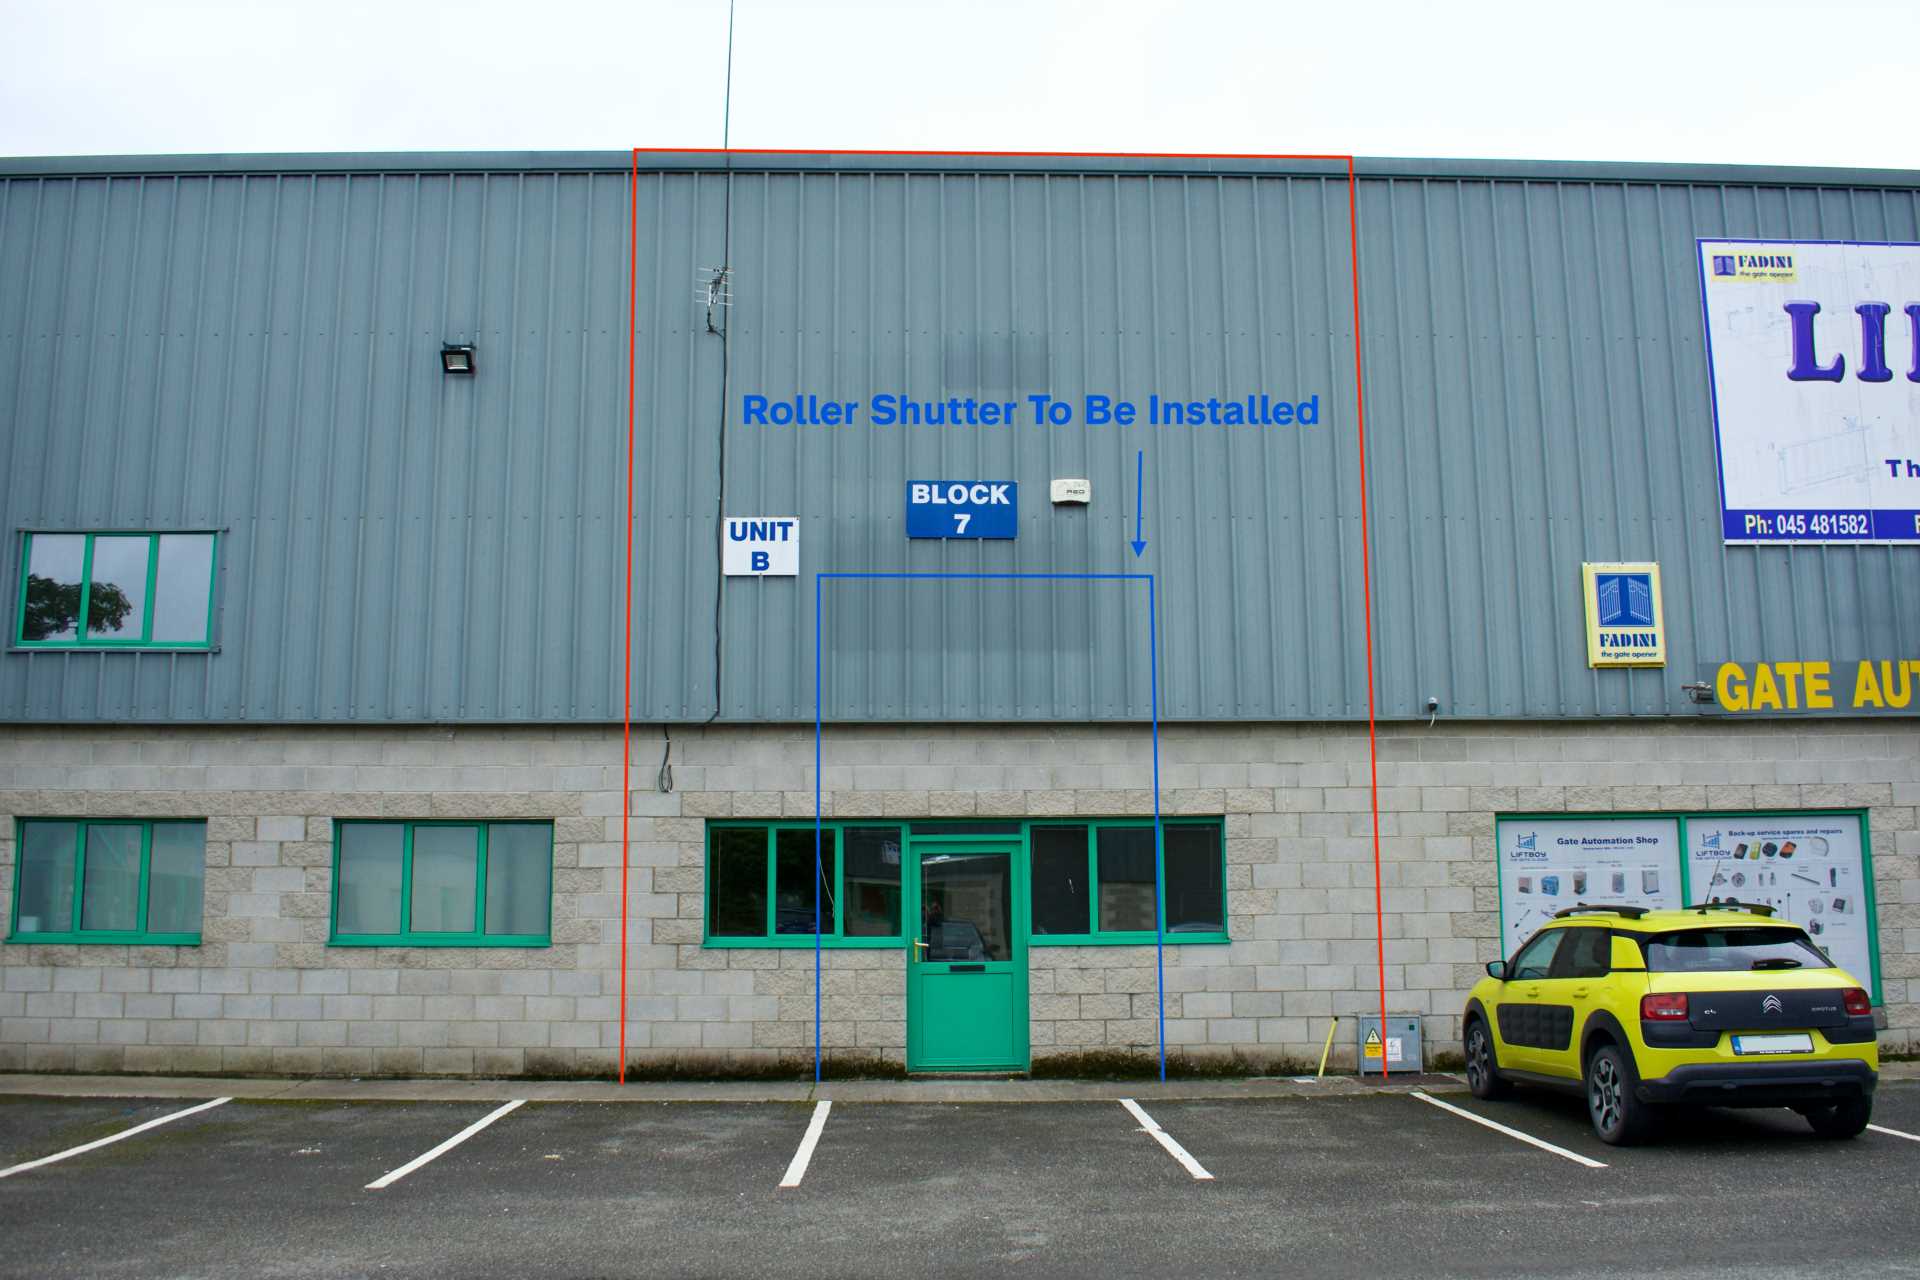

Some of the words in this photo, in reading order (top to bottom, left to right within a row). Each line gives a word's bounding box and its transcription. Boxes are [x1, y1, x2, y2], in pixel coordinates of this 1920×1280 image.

[1738, 255, 1793, 268] FADINI
[1783, 300, 1920, 383] LI
[911, 484, 1010, 505] BLOCK
[729, 521, 793, 541] UNIT
[953, 514, 971, 534] 7
[1744, 514, 1772, 534] Ph:
[1776, 514, 1806, 534] 045
[1810, 514, 1868, 534] 481582
[751, 551, 770, 571] B
[1600, 633, 1656, 647] FADINI
[1614, 651, 1630, 659] gate
[1716, 661, 1834, 711] GATE
[1557, 837, 1579, 845] Gate
[1581, 836, 1633, 845] Automation
[1635, 836, 1659, 846] Shop
